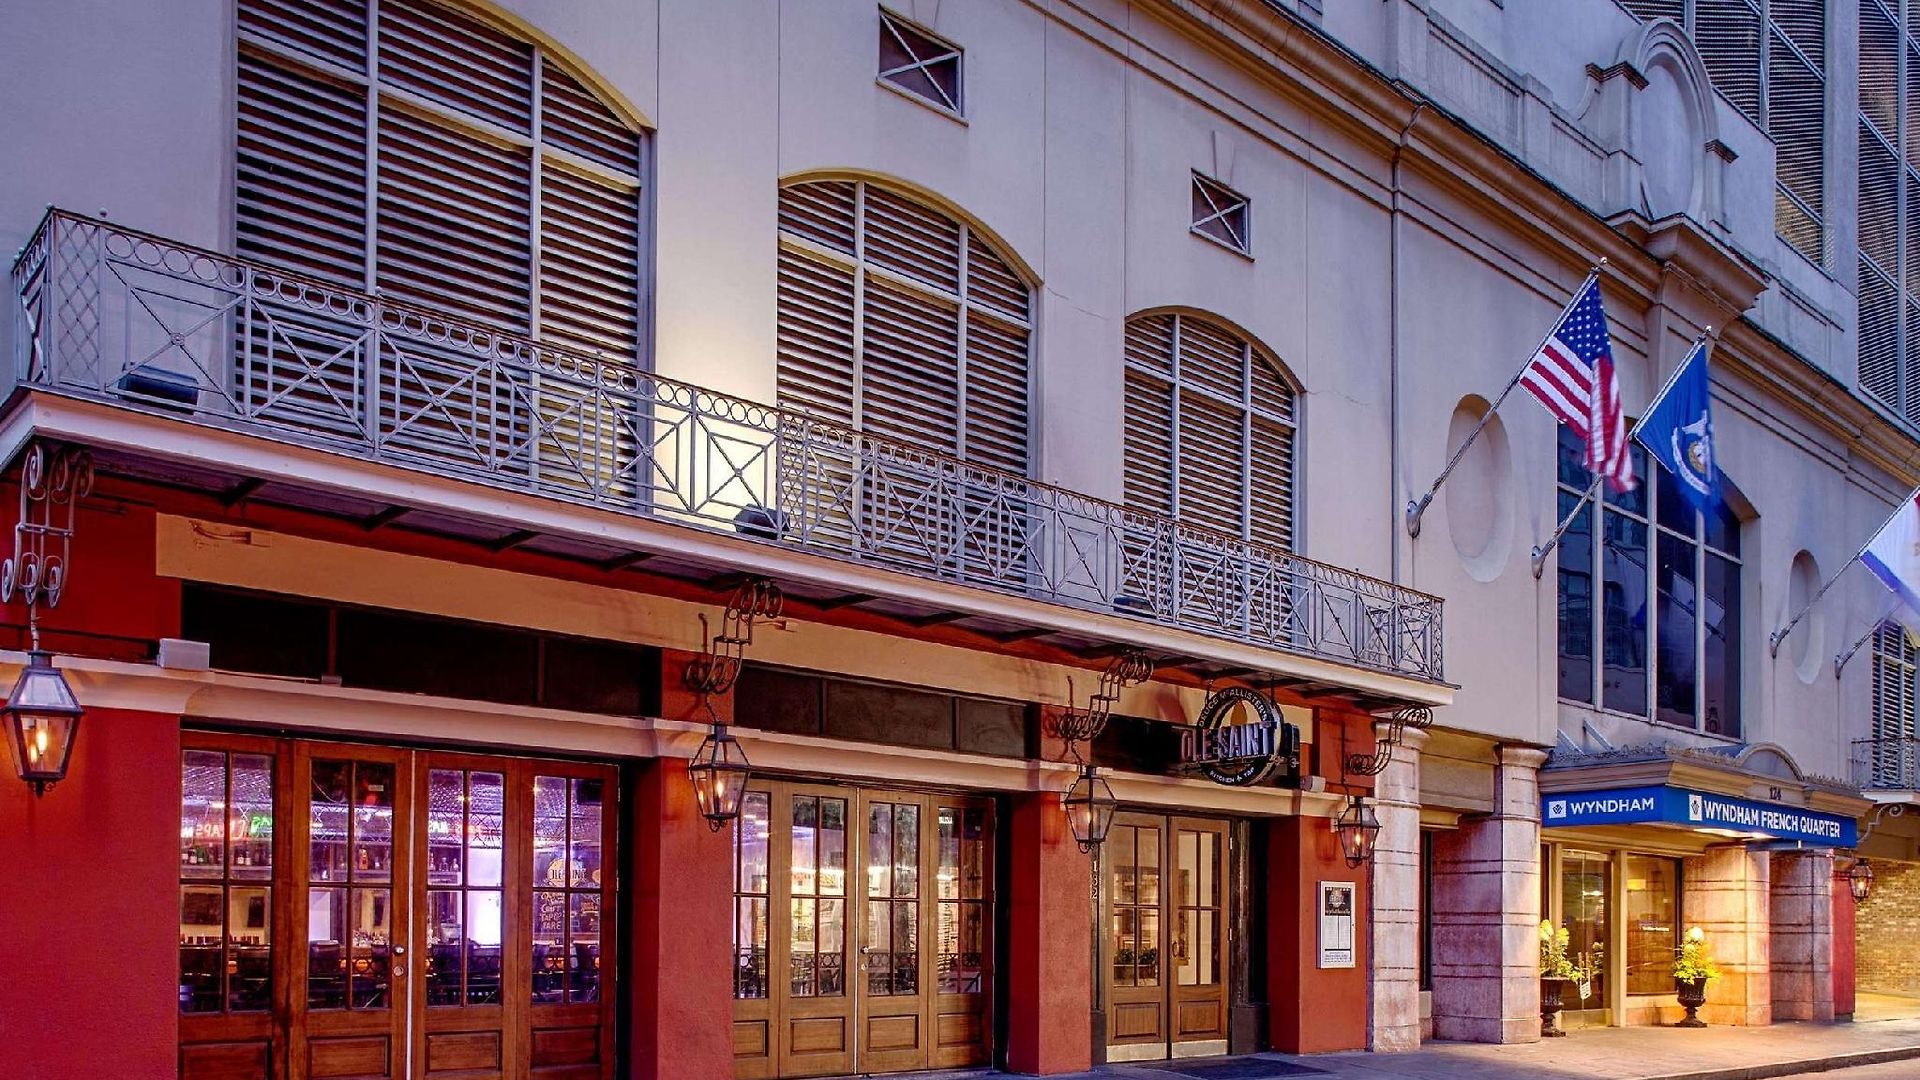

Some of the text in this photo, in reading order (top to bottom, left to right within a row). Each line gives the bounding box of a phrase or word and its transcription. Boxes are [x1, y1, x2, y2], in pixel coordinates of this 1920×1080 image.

[1217, 721, 1273, 759] SAINT
[1570, 798, 1654, 815] WYNDHAM
[1703, 800, 1840, 838] WYNDHAM FRENCH QUARTER
